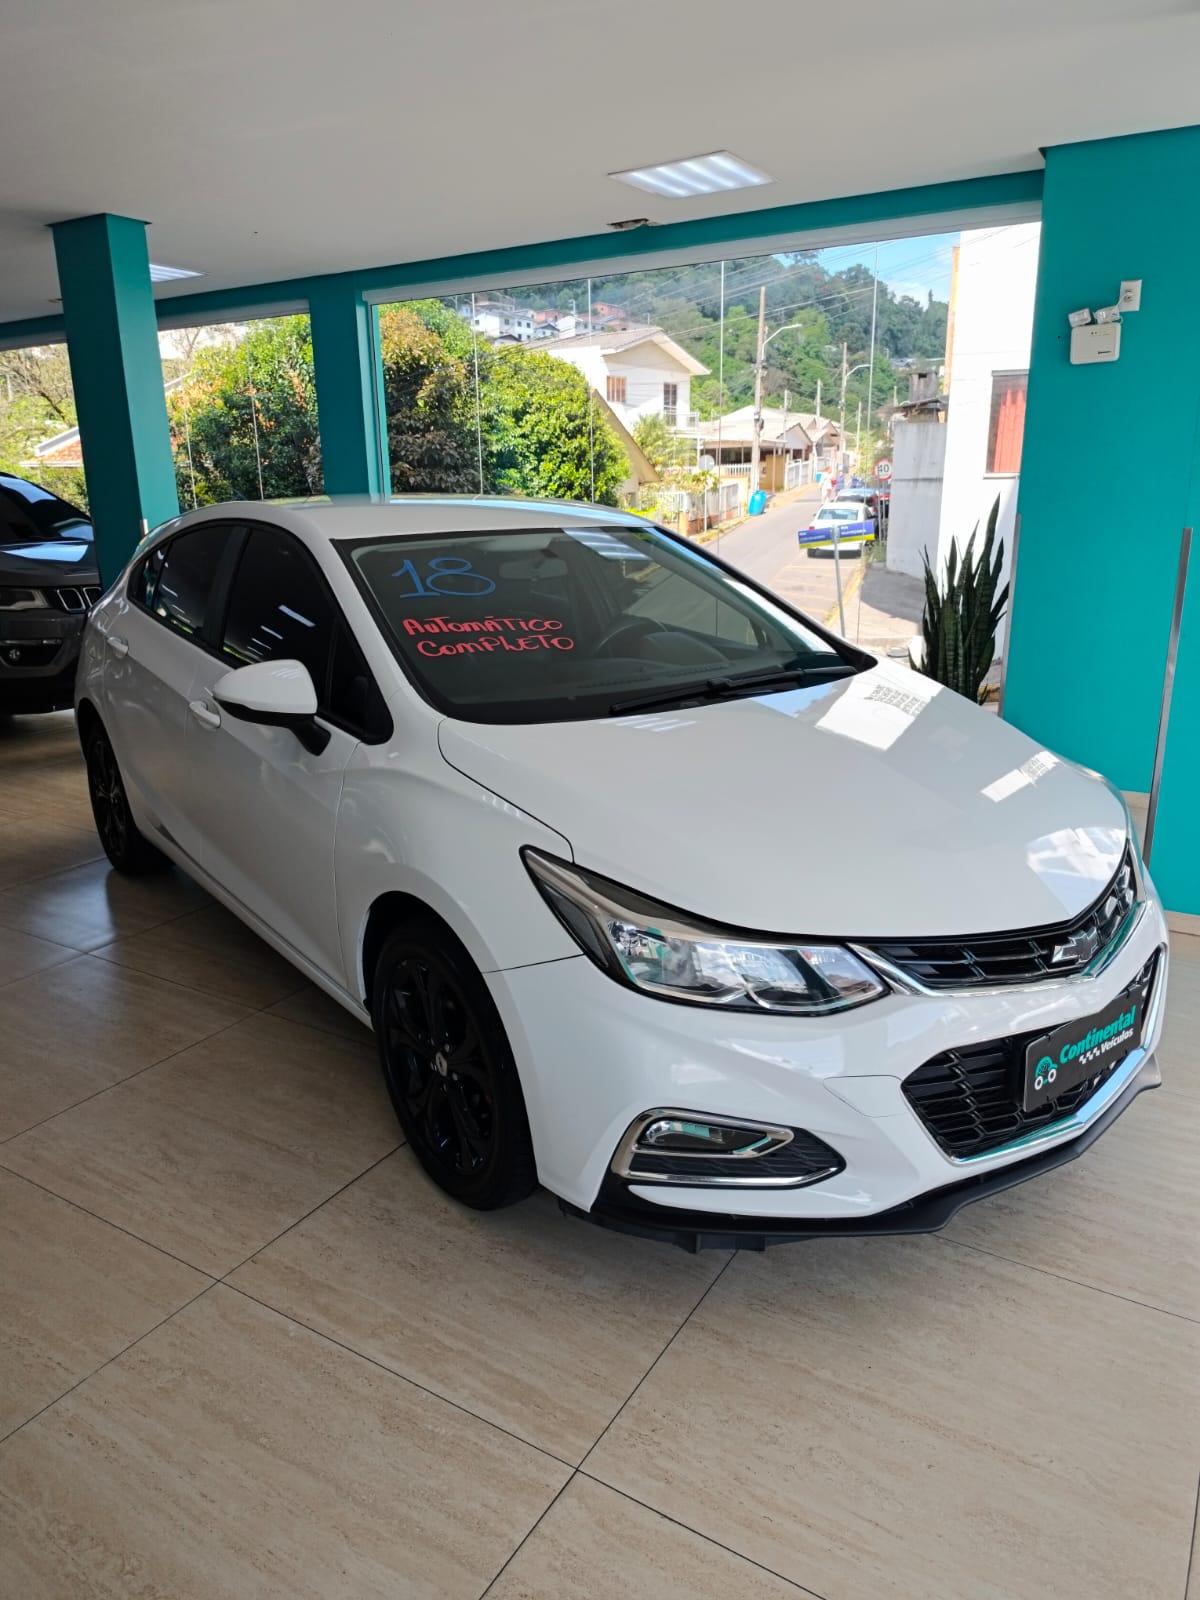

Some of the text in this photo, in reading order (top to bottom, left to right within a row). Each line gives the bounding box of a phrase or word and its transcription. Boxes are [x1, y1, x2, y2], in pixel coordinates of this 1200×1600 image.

[877, 464, 890, 473] 40
[392, 557, 496, 598] 18
[1059, 1005, 1137, 1063] Continental
